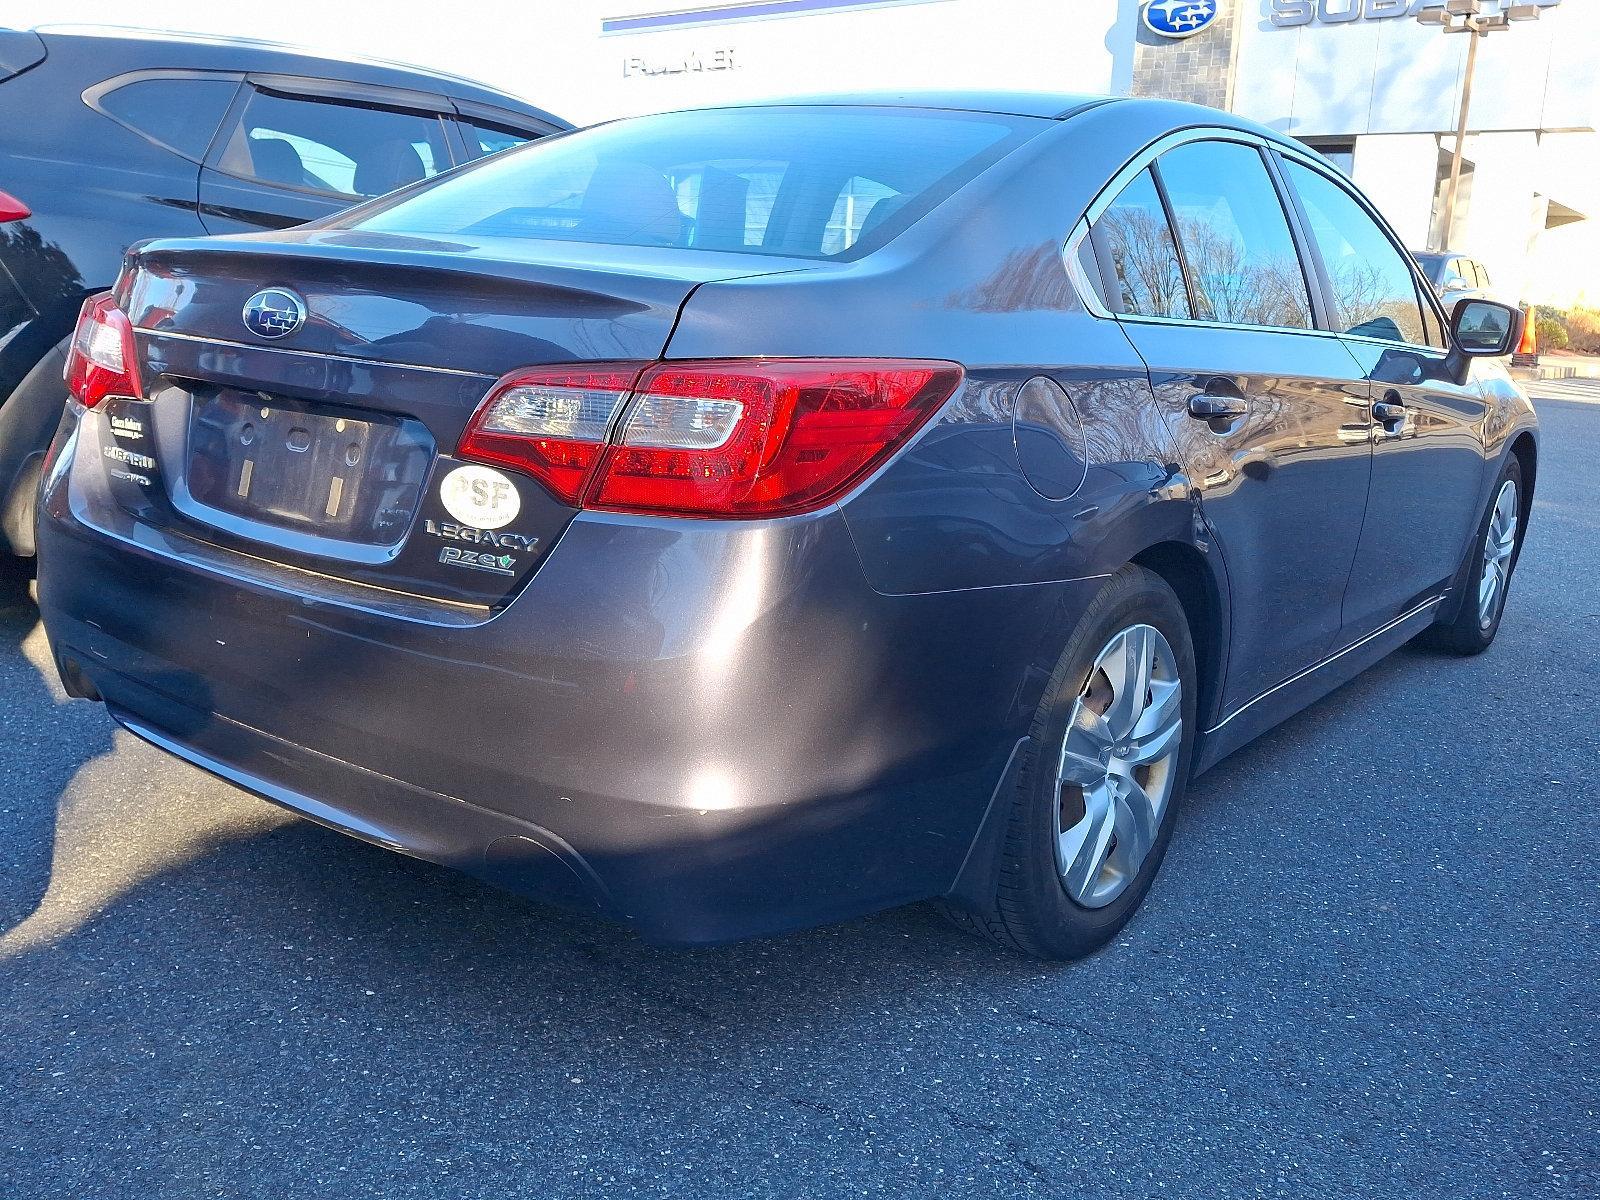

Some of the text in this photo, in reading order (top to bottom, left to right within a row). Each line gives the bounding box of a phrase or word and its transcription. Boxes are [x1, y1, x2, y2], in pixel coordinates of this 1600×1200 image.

[104, 446, 155, 469] SUBARU
[449, 474, 510, 509] PSF
[424, 519, 539, 552] LEGACY
